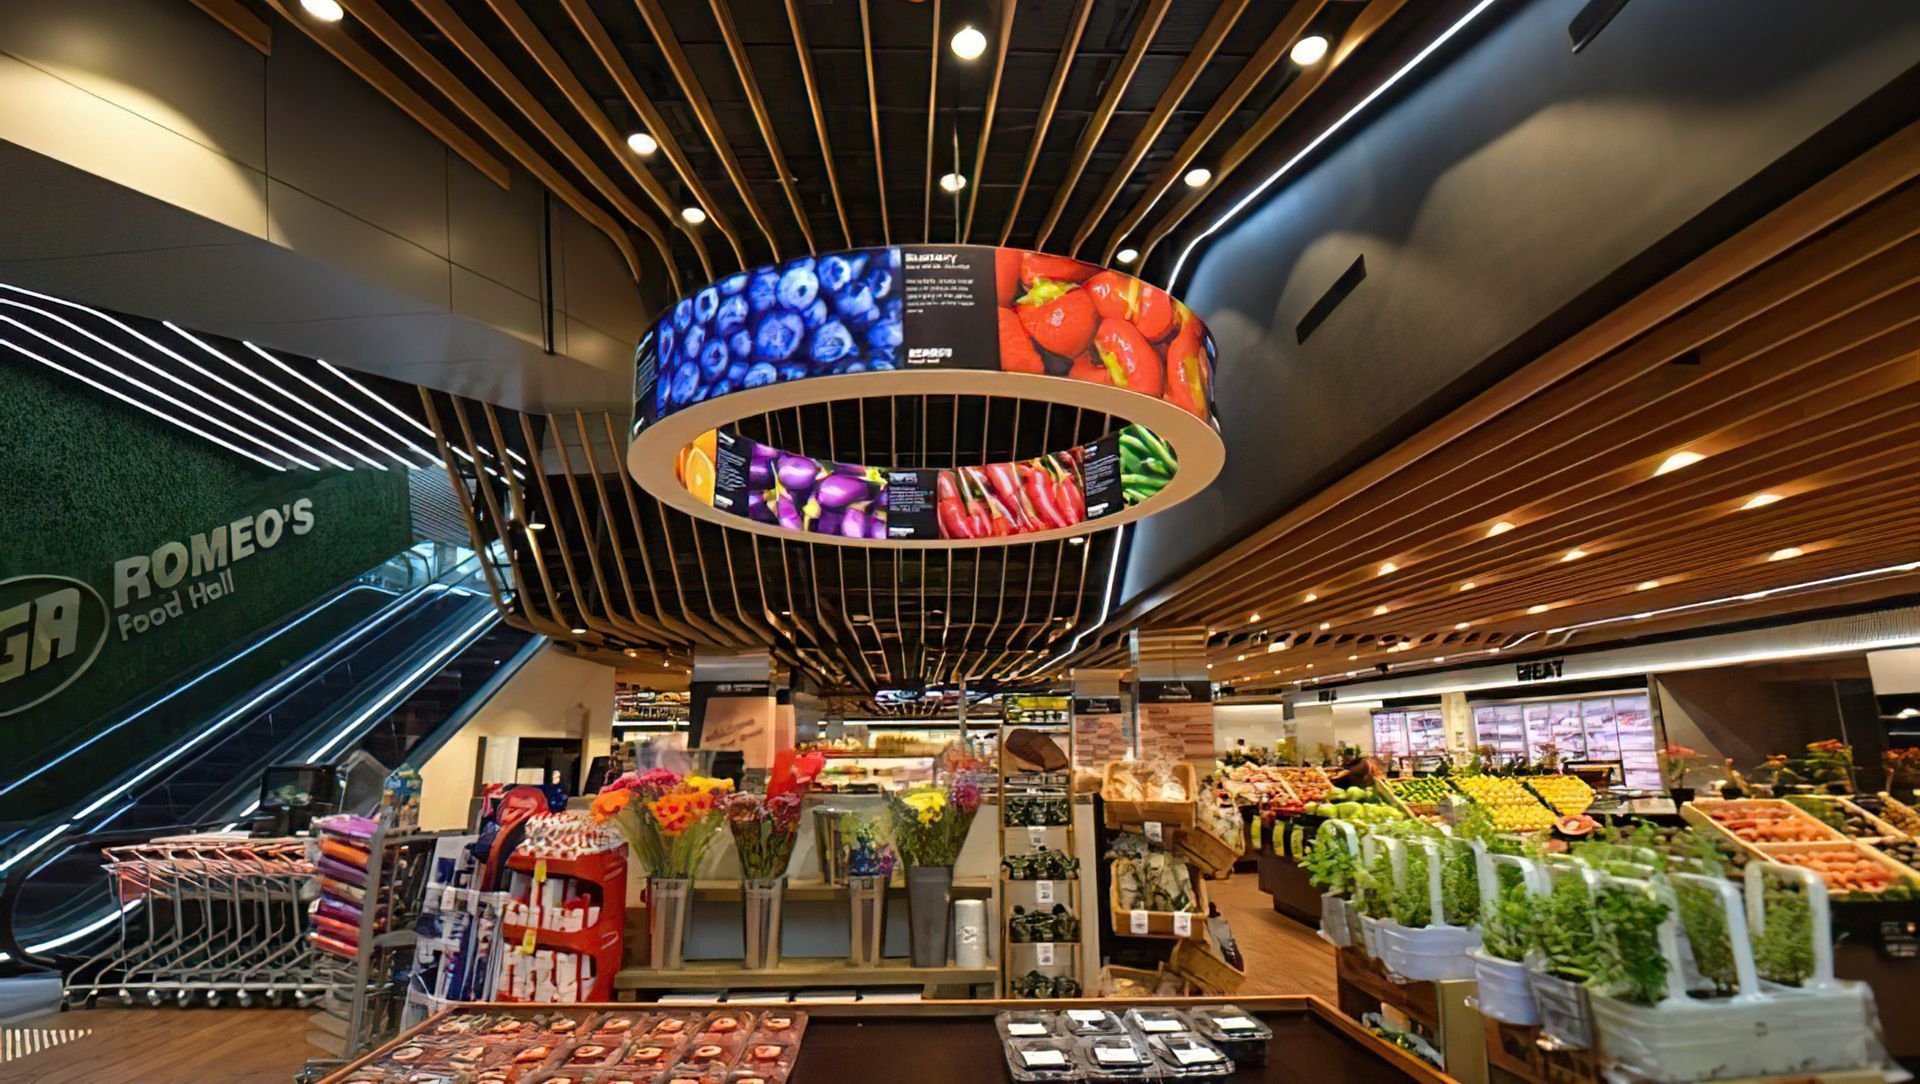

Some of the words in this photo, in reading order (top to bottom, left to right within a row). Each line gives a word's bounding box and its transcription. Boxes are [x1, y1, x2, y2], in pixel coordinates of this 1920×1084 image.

[114, 498, 315, 609] ROMEO'S
[118, 590, 184, 641] Food
[188, 568, 235, 609] Hall
